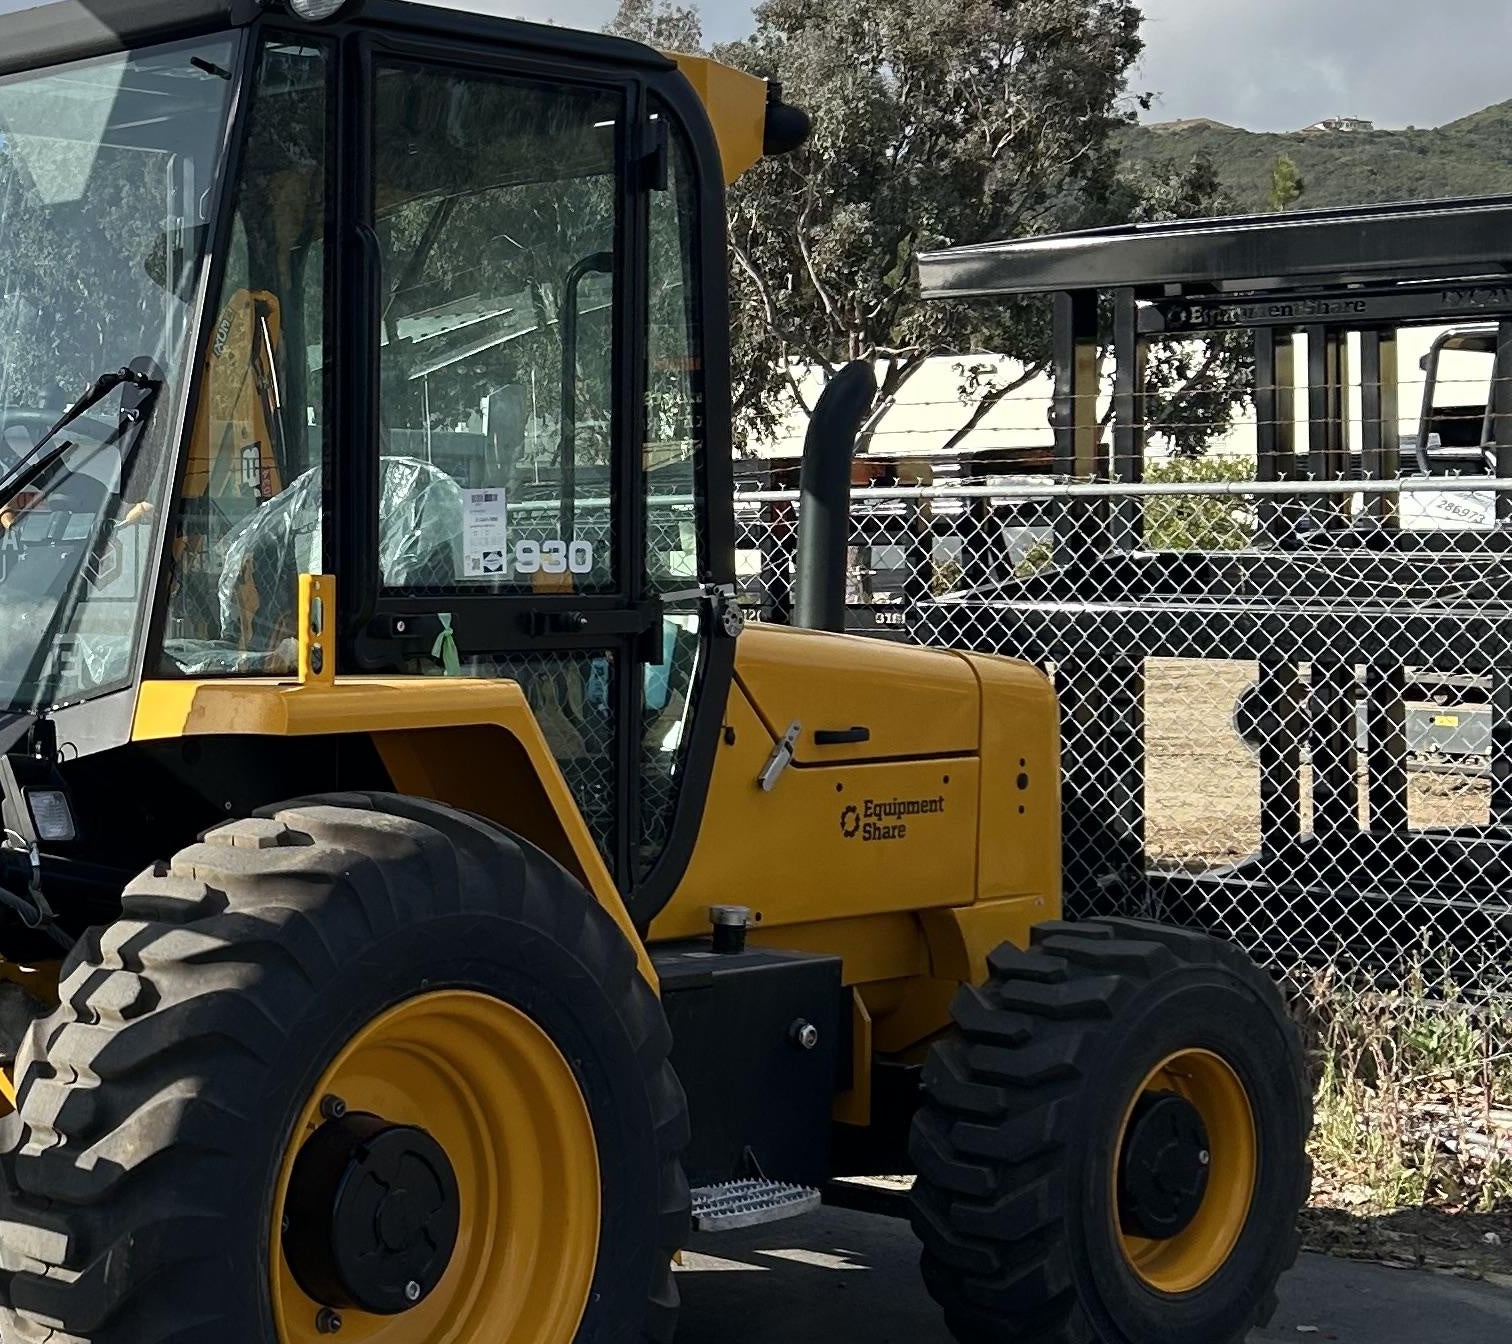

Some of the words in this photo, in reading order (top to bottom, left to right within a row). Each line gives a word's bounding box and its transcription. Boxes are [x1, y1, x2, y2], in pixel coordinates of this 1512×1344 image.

[515, 540, 593, 573] 930
[864, 796, 944, 821] Equipment
[863, 822, 906, 841] Share
